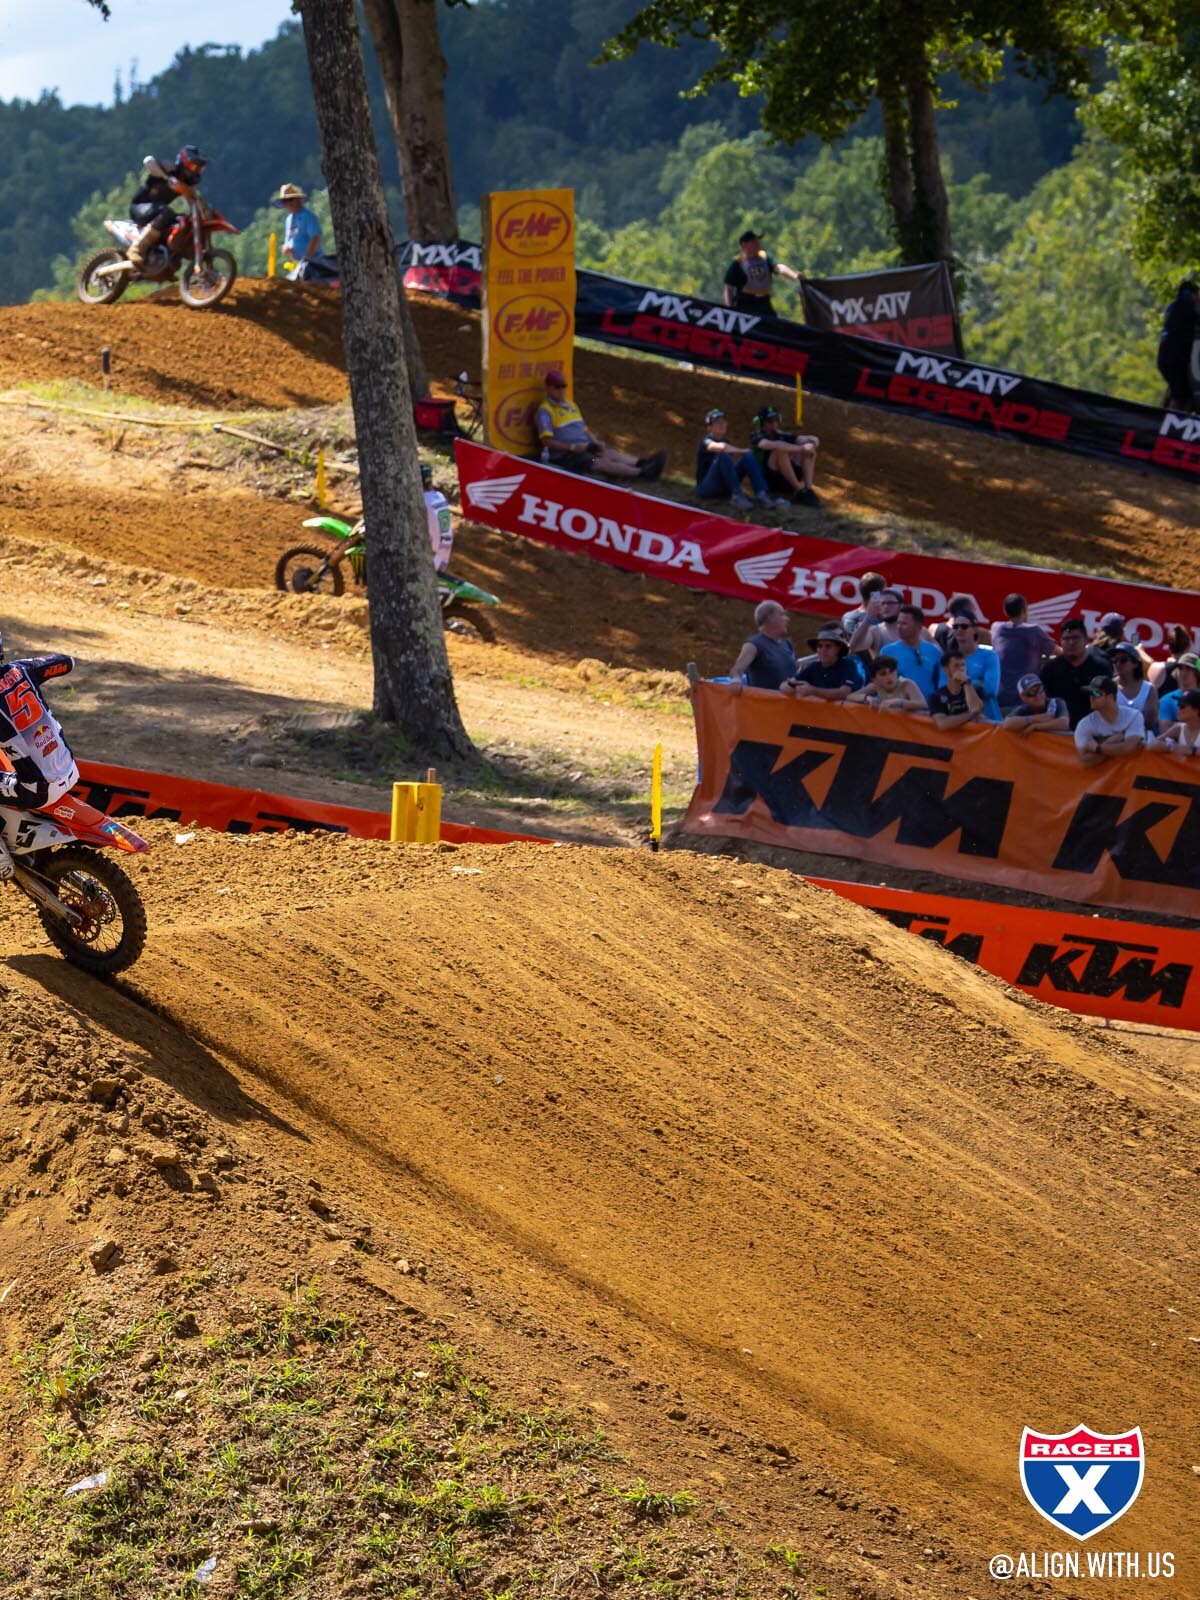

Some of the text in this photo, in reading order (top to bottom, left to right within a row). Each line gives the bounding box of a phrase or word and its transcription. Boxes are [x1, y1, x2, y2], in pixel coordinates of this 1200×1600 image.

[504, 212, 561, 238] FMF
[504, 306, 561, 333] FMF
[638, 292, 693, 322] MX
[697, 307, 761, 334] ATV
[831, 297, 867, 325] MX
[872, 291, 911, 320] ATV
[600, 307, 809, 377] LEGENDS
[895, 351, 952, 383] MX
[957, 368, 1023, 396] ATV
[855, 368, 1072, 441] LEGENDS
[518, 493, 710, 575] HONDA
[788, 567, 990, 623] HODA
[5, 680, 43, 731] 5
[711, 724, 1014, 859] KTM
[1016, 934, 1193, 1009] KTM
